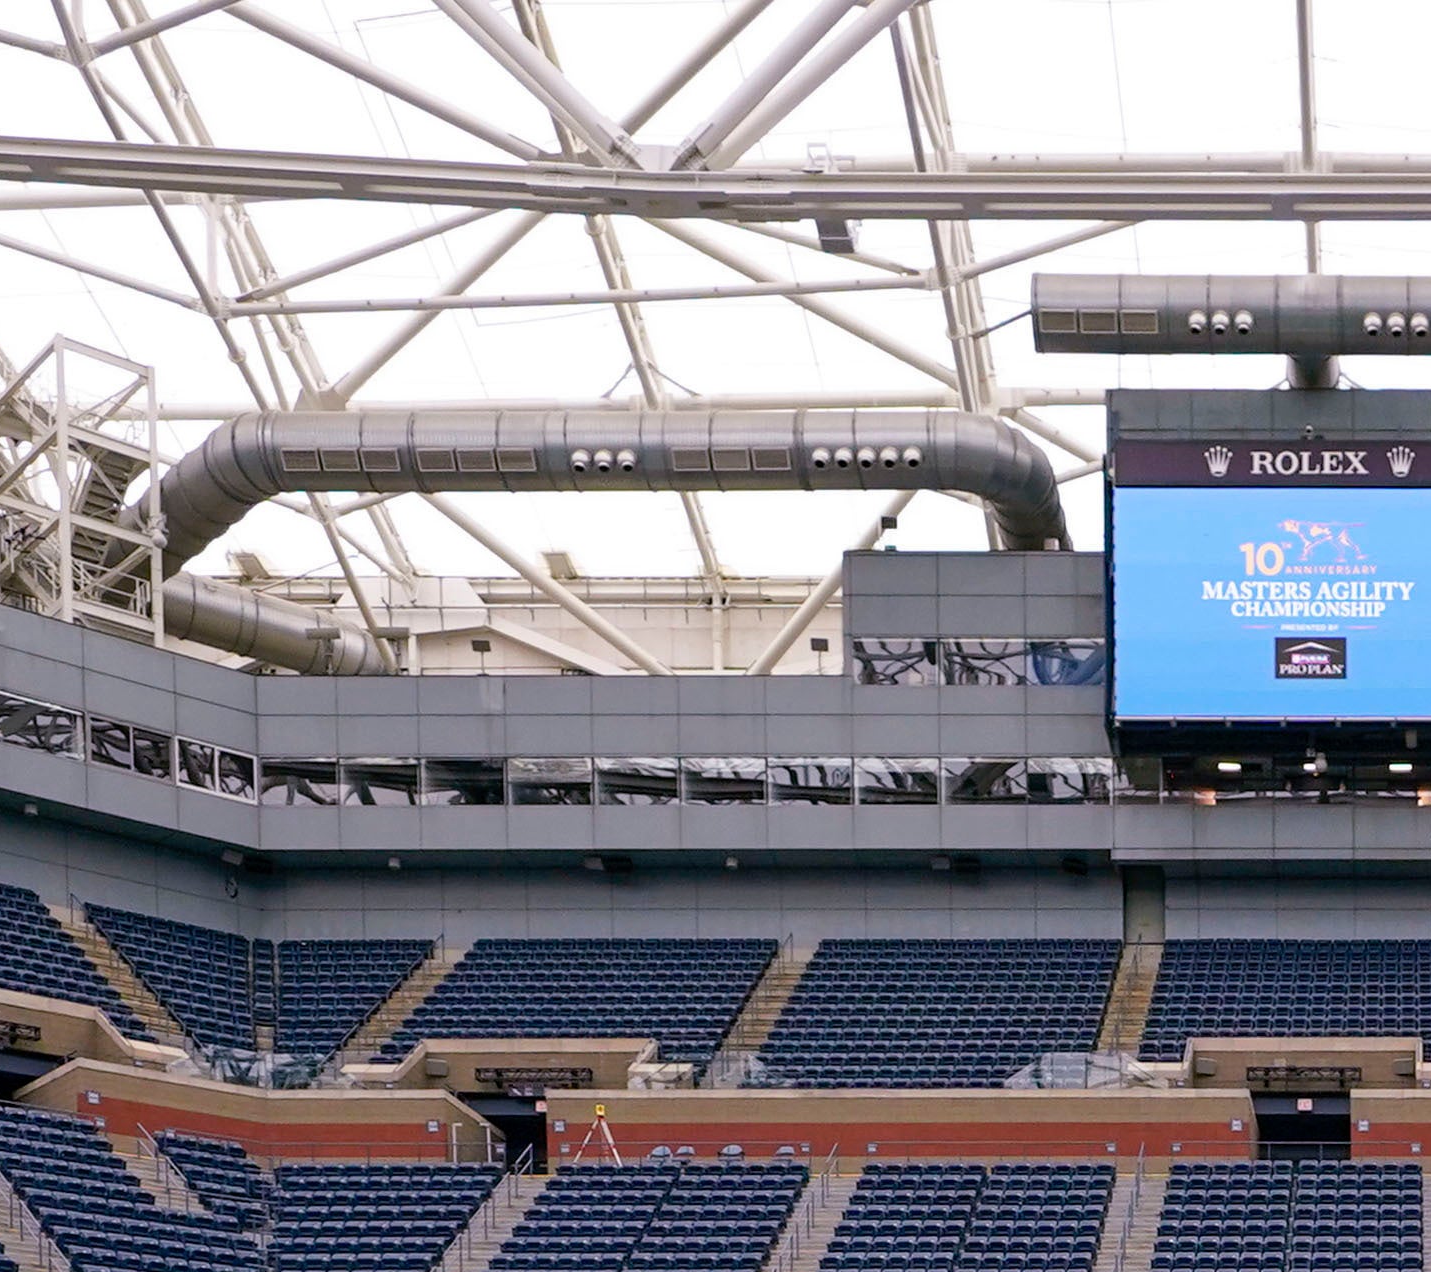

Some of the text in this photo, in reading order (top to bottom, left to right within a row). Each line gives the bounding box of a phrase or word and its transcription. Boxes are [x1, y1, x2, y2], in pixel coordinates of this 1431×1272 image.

[1250, 451, 1369, 475] ROLEX
[1285, 565, 1377, 575] ANNIVERSARY
[1201, 581, 1415, 600] MASTERS AGILITY
[1231, 602, 1386, 617] CHAMPIONSHIP
[1279, 664, 1344, 675] PRO PLAN
